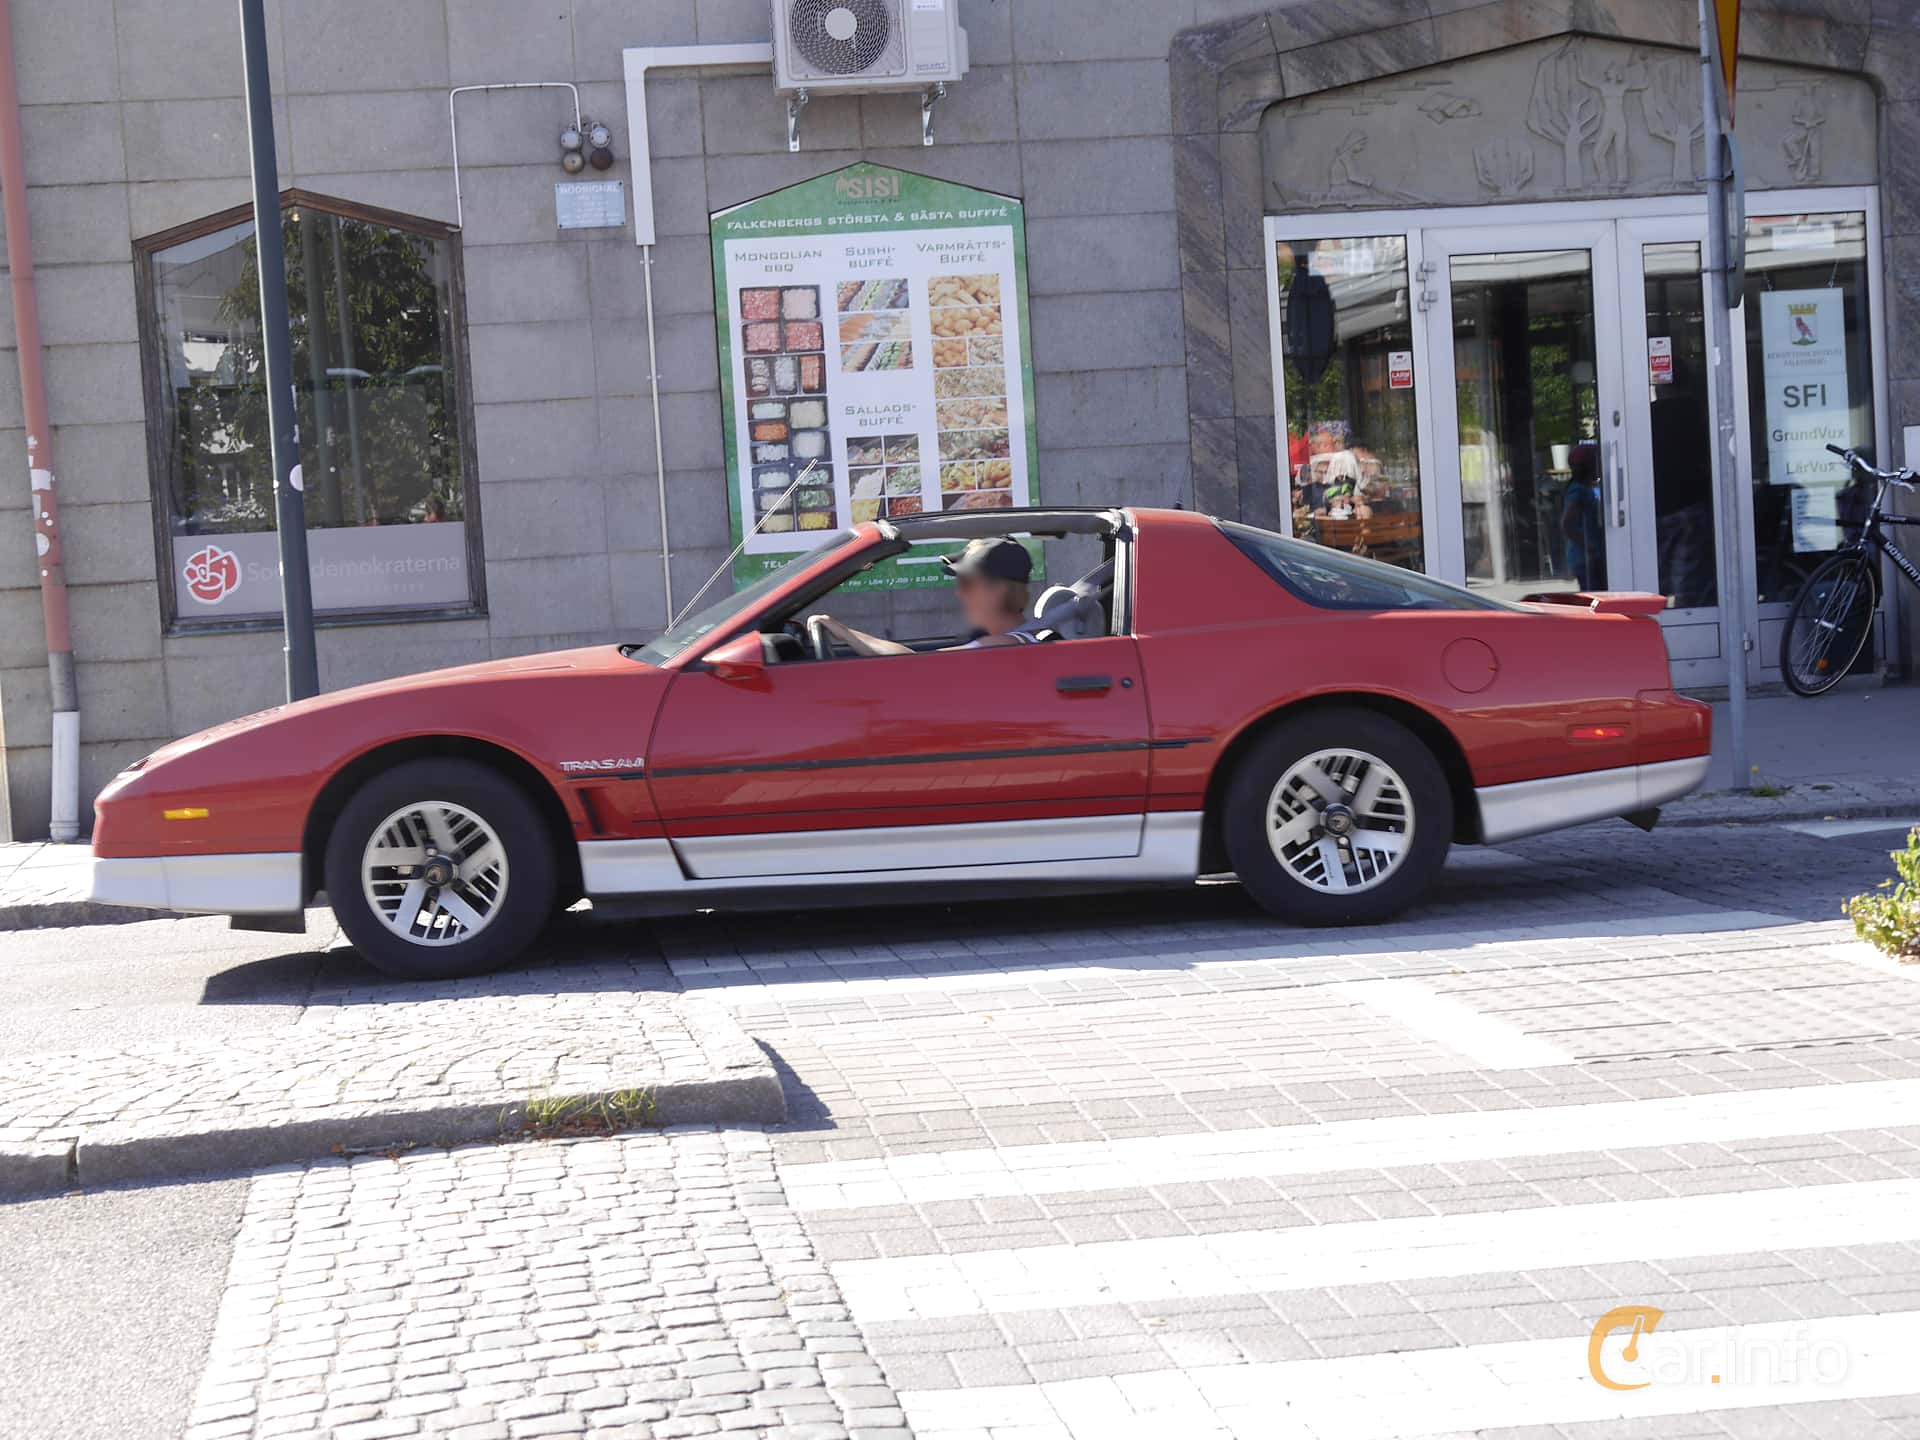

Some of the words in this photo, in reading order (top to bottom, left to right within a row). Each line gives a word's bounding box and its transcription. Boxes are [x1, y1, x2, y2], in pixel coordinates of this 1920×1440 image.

[846, 175, 899, 198] SISI
[727, 217, 822, 230] FALKENBERGS
[828, 213, 889, 225] STÖRSTA
[894, 211, 905, 222] &
[911, 209, 953, 221] BÄSTA
[1783, 384, 1826, 408] SFI
[1773, 426, 1845, 442] GrundVux
